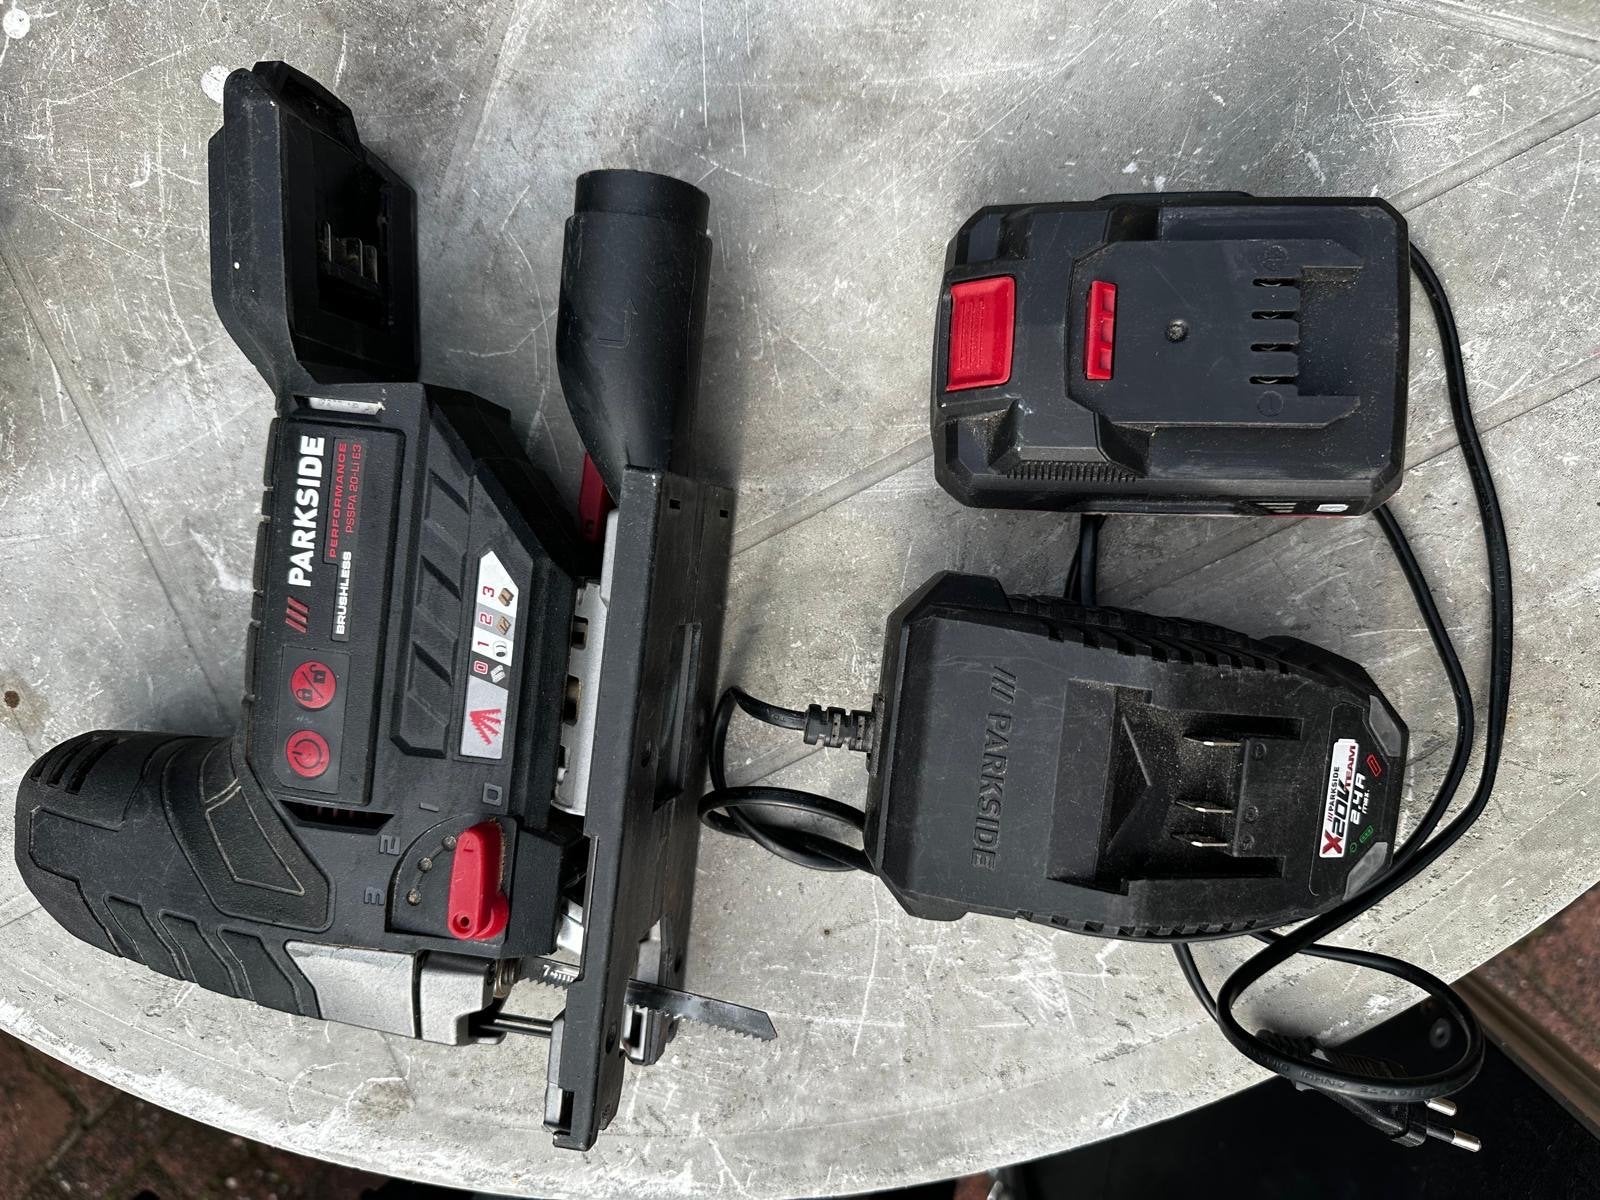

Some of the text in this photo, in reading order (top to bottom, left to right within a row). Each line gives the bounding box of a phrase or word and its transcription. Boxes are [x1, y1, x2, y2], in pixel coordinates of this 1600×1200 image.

[329, 442, 347, 558] PERFORMANCE
[345, 495, 358, 534] PSSPA
[353, 443, 362, 460] E3
[288, 435, 325, 587] PARKSIDE
[335, 551, 352, 635] BRUSHLESS
[483, 586, 494, 598] 3
[480, 613, 492, 625] 2
[474, 660, 488, 674] 0
[1344, 745, 1356, 789] TEAM
[1356, 772, 1366, 790] A
[971, 712, 1013, 871] PARKSIDE
[1328, 766, 1340, 812] PARKSIDE
[1362, 789, 1370, 814] max.
[379, 834, 400, 855] 2
[364, 886, 385, 905] 3
